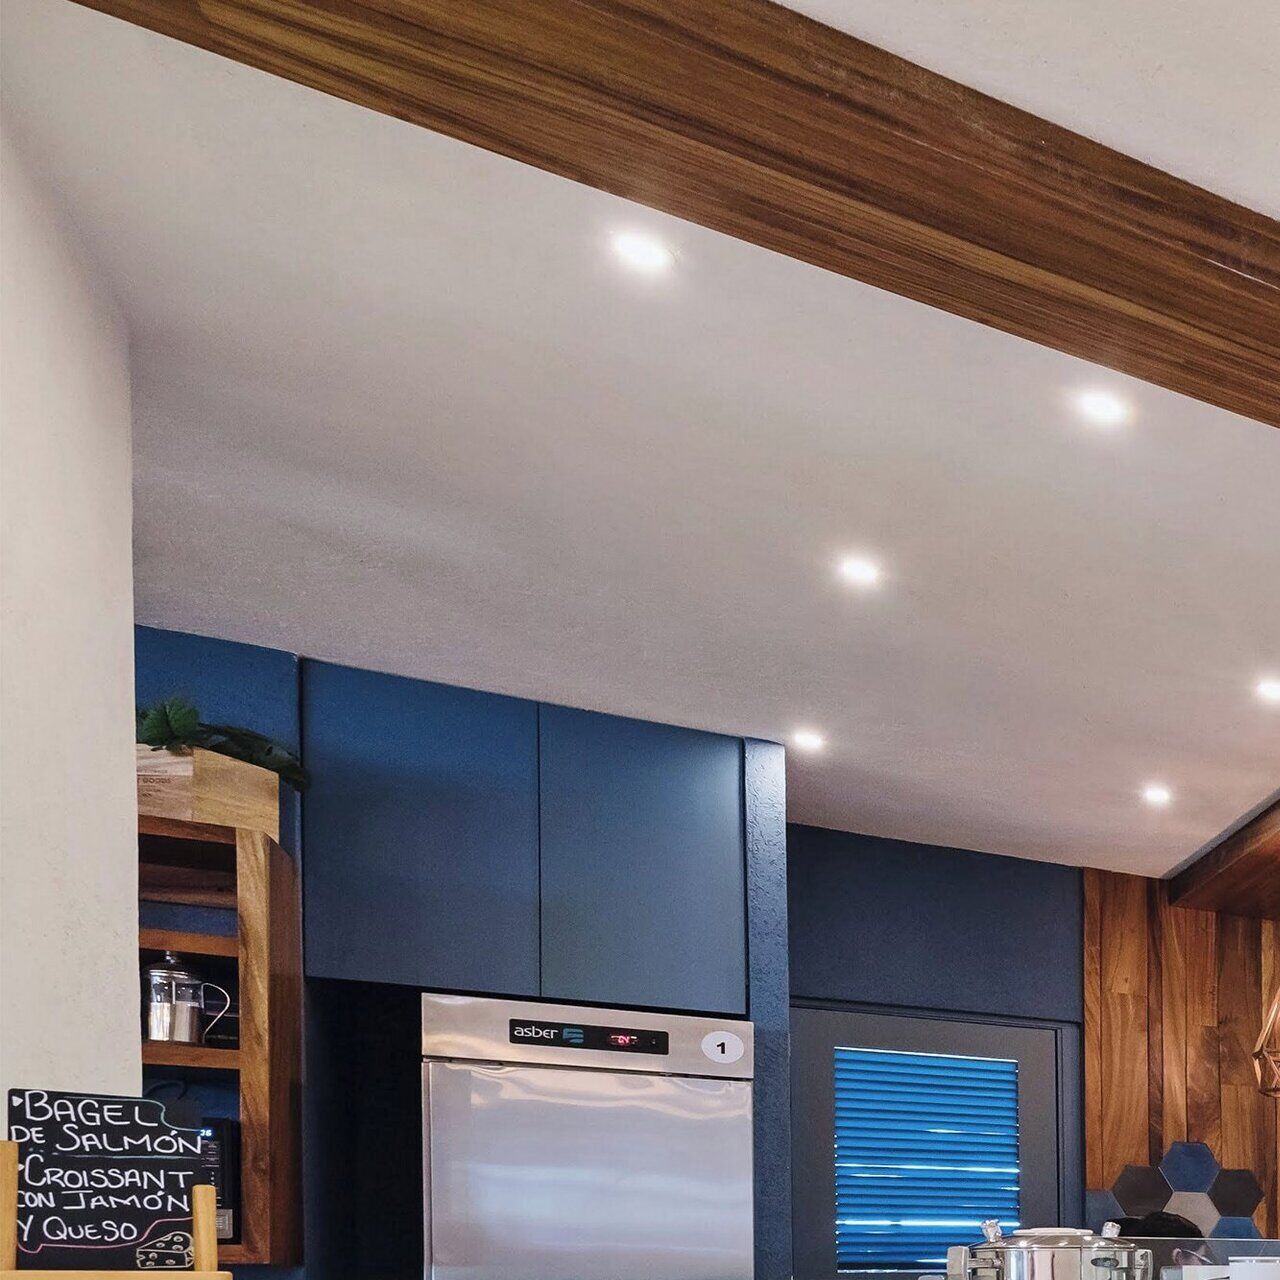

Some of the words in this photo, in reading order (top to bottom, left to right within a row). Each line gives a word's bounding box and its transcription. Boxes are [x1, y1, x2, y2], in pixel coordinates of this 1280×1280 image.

[514, 1026, 558, 1039] asber
[716, 1042, 726, 1054] 1
[25, 1091, 158, 1126] BAGEL
[11, 1125, 46, 1143] DE
[56, 1123, 201, 1154] SALMÓN
[24, 1154, 194, 1189] CROISSANT
[17, 1191, 56, 1208] CON
[61, 1190, 190, 1212] JAMÓN
[17, 1215, 34, 1242] Y
[43, 1216, 138, 1242] QUESO
